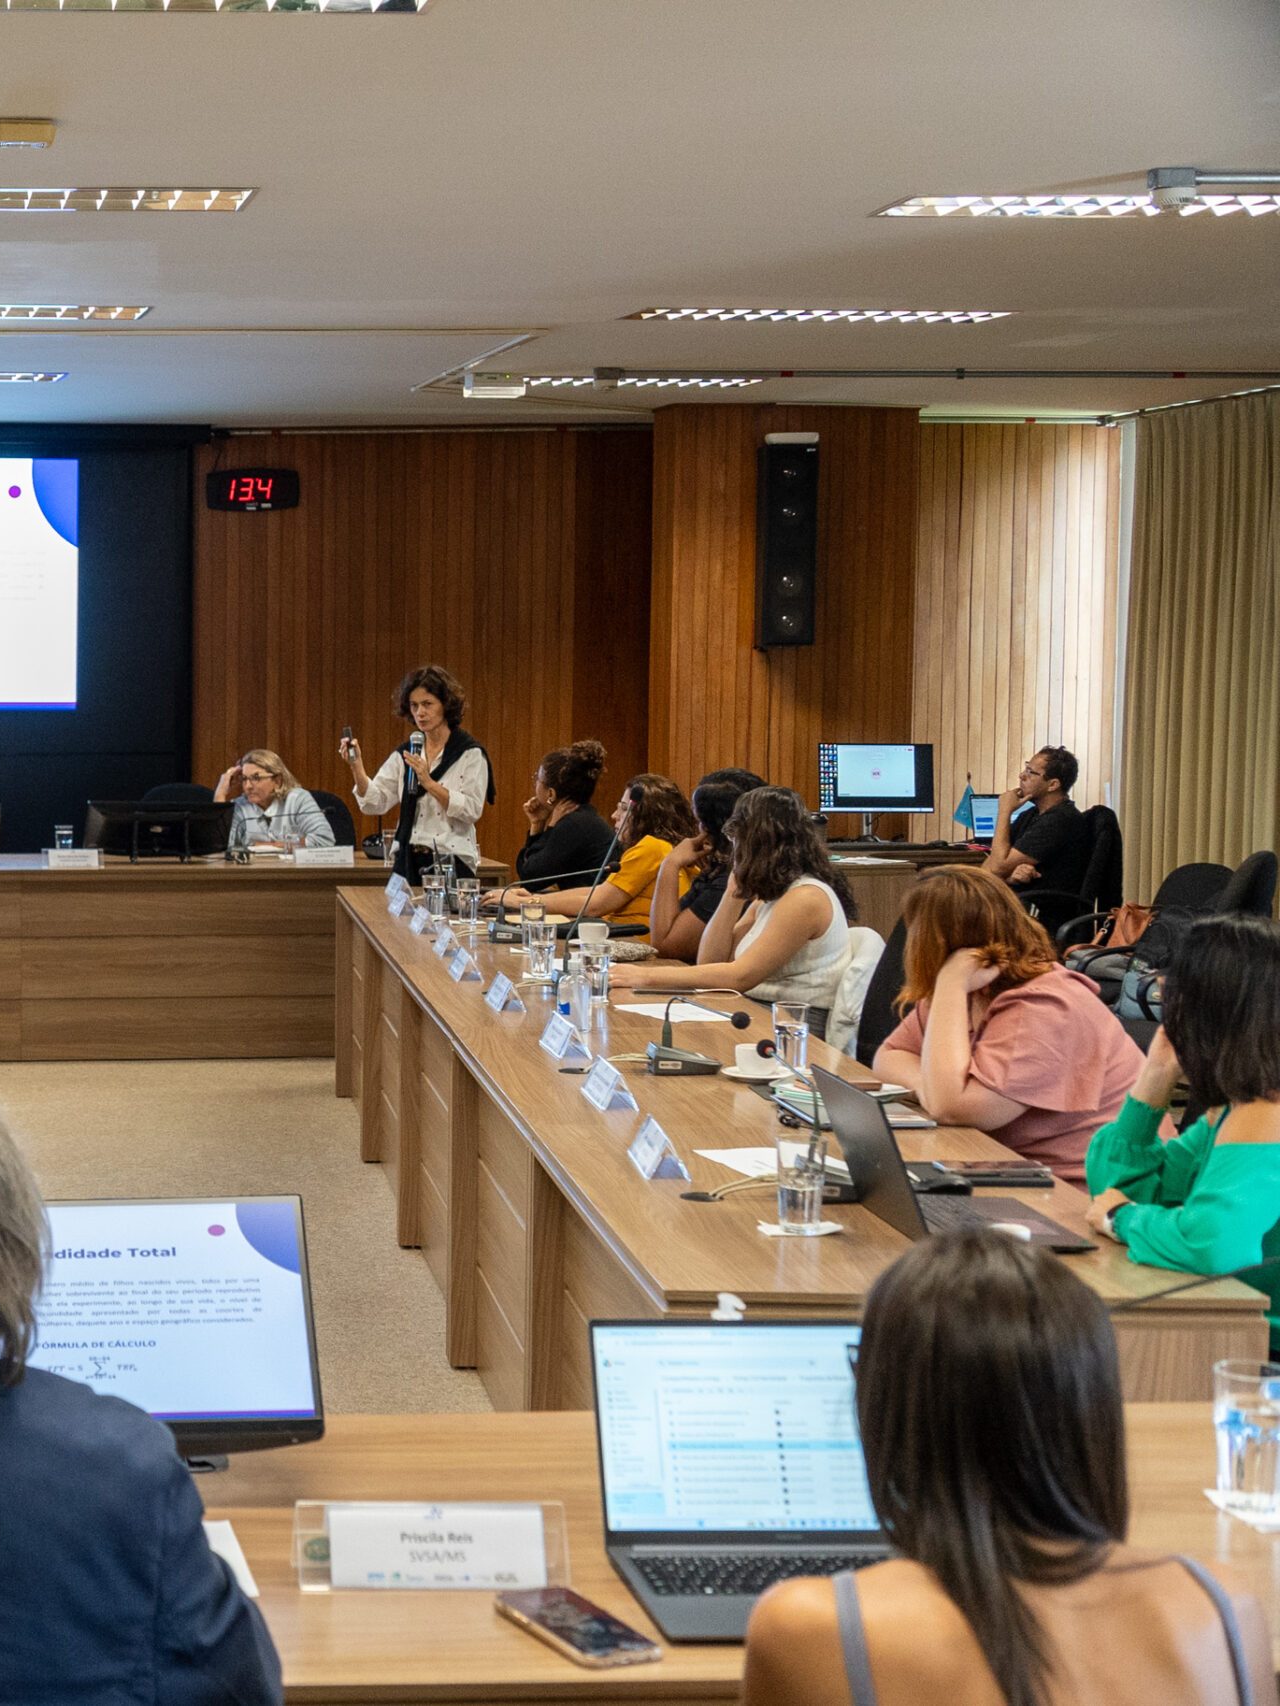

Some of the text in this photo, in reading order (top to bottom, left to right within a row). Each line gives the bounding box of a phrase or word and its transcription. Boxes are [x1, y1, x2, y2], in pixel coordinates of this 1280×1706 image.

[54, 1246, 177, 1259] didade Total
[215, 1287, 261, 1295] reprodutivo
[141, 1298, 162, 1307] longo
[91, 1340, 104, 1348] DE
[108, 1338, 156, 1348] CÁLCULO
[400, 1532, 473, 1544] Priscila Reis
[409, 1550, 467, 1564] SVSA/MS
